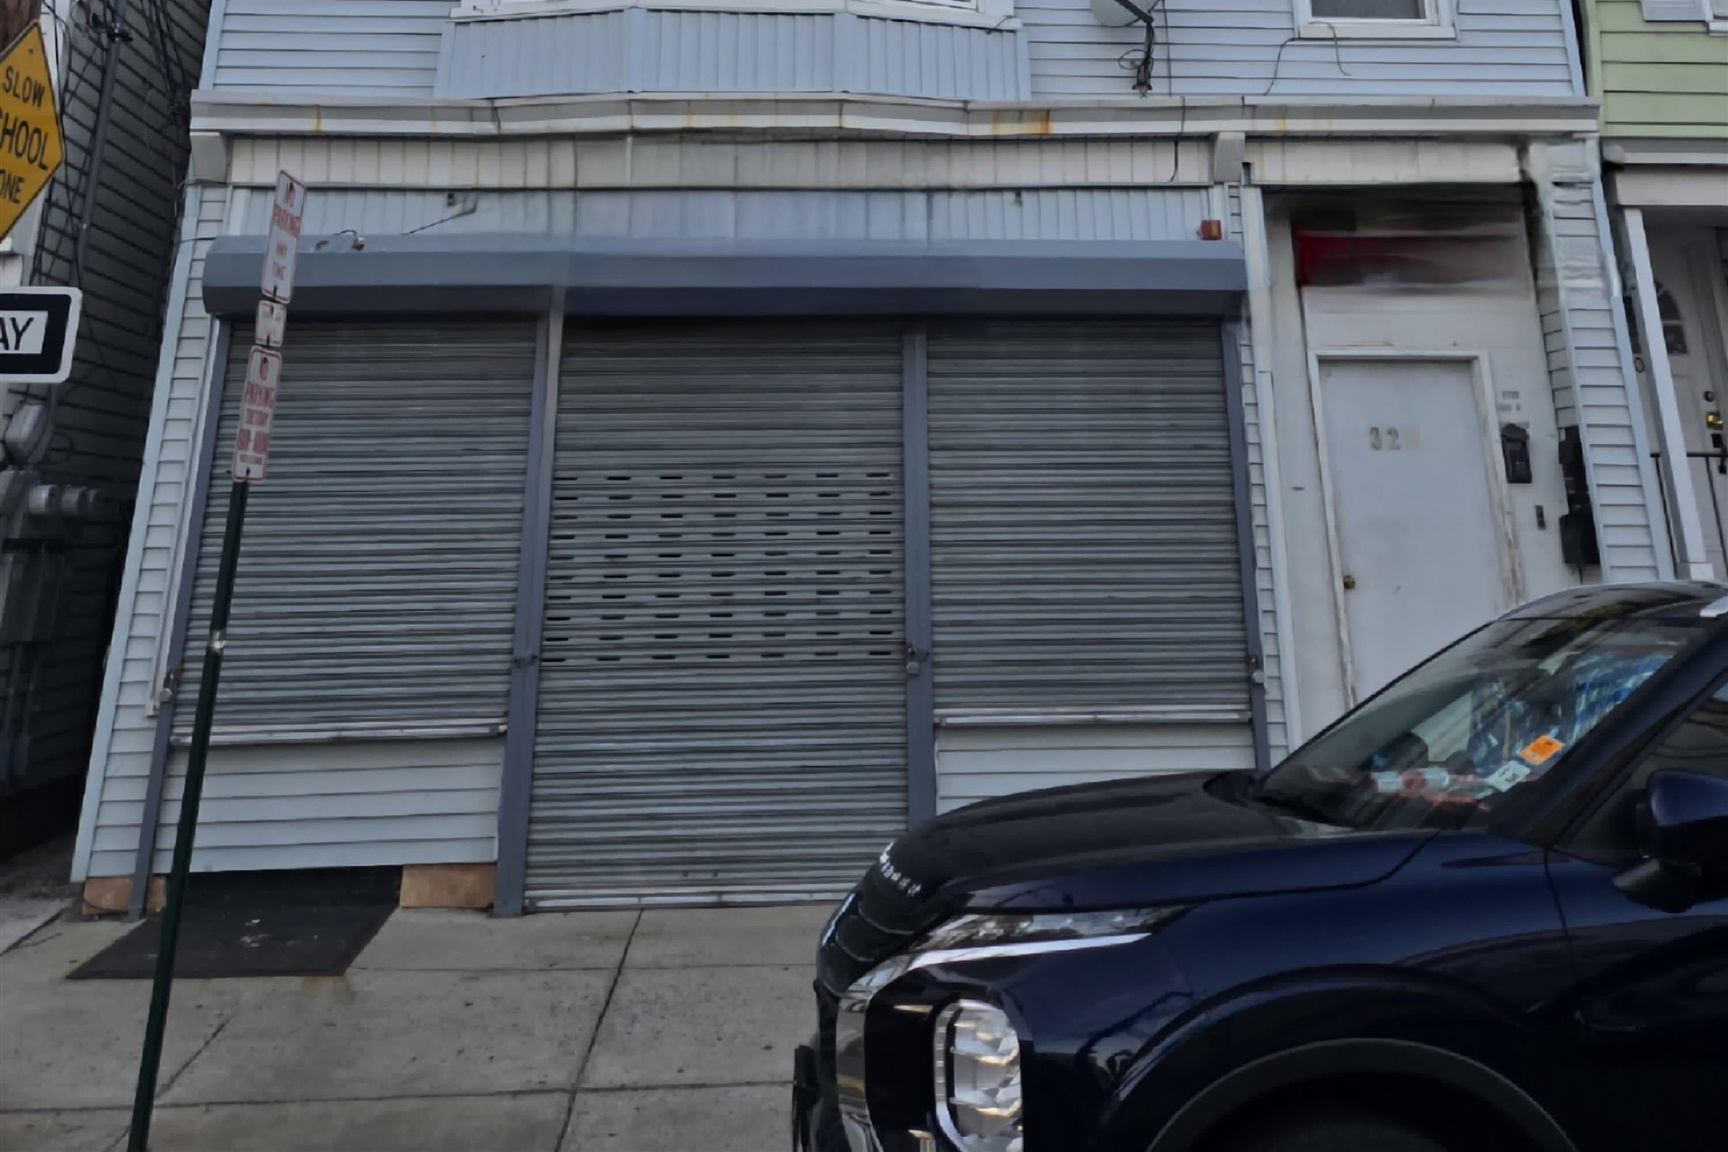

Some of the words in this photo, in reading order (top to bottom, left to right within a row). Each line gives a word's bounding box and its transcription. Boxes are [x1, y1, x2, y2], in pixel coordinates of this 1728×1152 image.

[3, 65, 45, 109] SLOW
[0, 107, 48, 170] HOOL
[0, 169, 24, 204] ONE
[0, 317, 34, 350] AY
